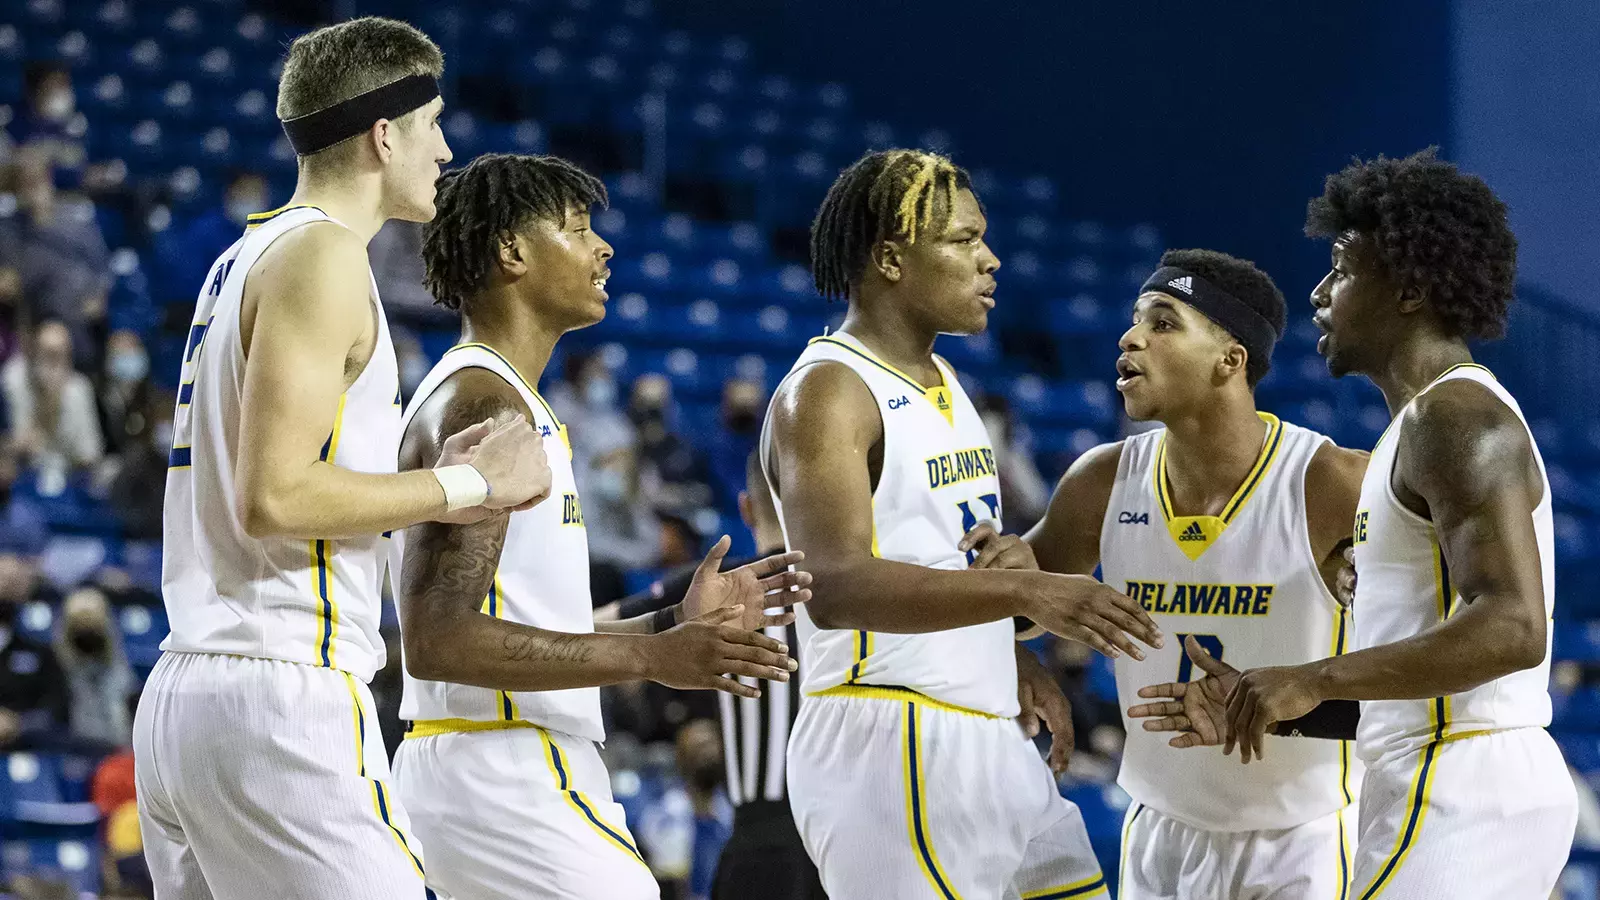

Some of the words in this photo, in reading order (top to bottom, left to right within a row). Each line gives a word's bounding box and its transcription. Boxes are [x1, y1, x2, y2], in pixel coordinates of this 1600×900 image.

[889, 395, 911, 410] CAA
[1118, 511, 1149, 525] CAA
[1124, 580, 1276, 616] DELAWARE
